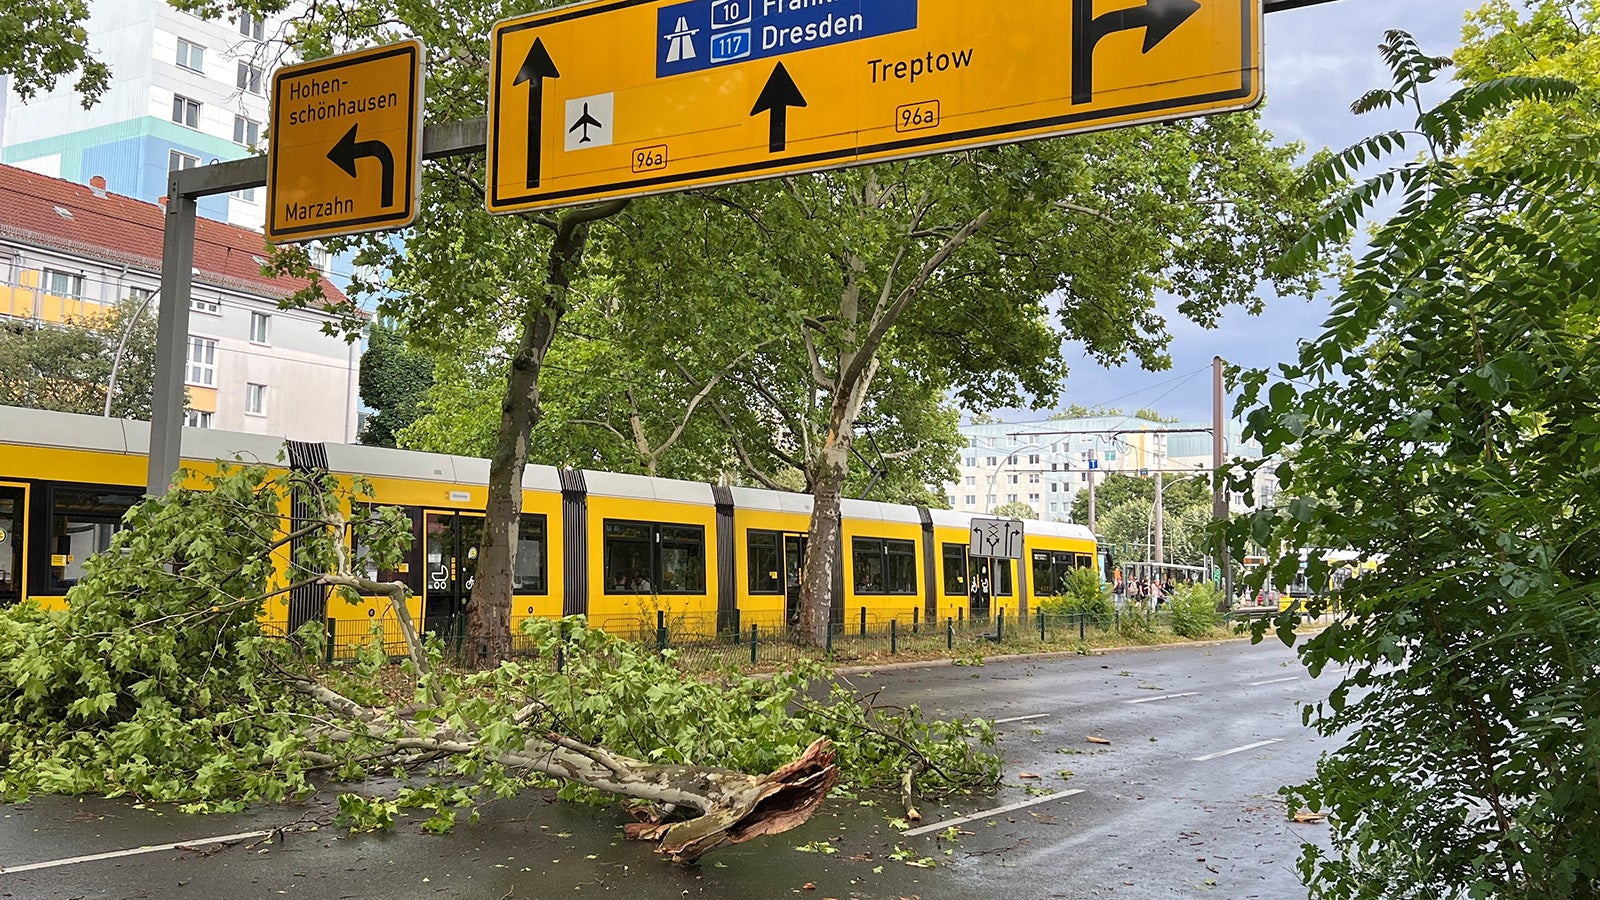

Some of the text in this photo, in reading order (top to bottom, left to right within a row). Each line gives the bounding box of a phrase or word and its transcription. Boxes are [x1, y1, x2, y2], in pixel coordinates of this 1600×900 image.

[723, 2, 740, 21] 10
[762, 13, 863, 50] Dresden
[719, 35, 742, 56] 117
[867, 48, 974, 83] Treptow
[290, 77, 349, 101] Hohen-
[289, 92, 397, 126] schönhausen
[901, 107, 934, 127] 96a
[637, 150, 663, 168] 96a
[285, 196, 354, 222] Marzahn
